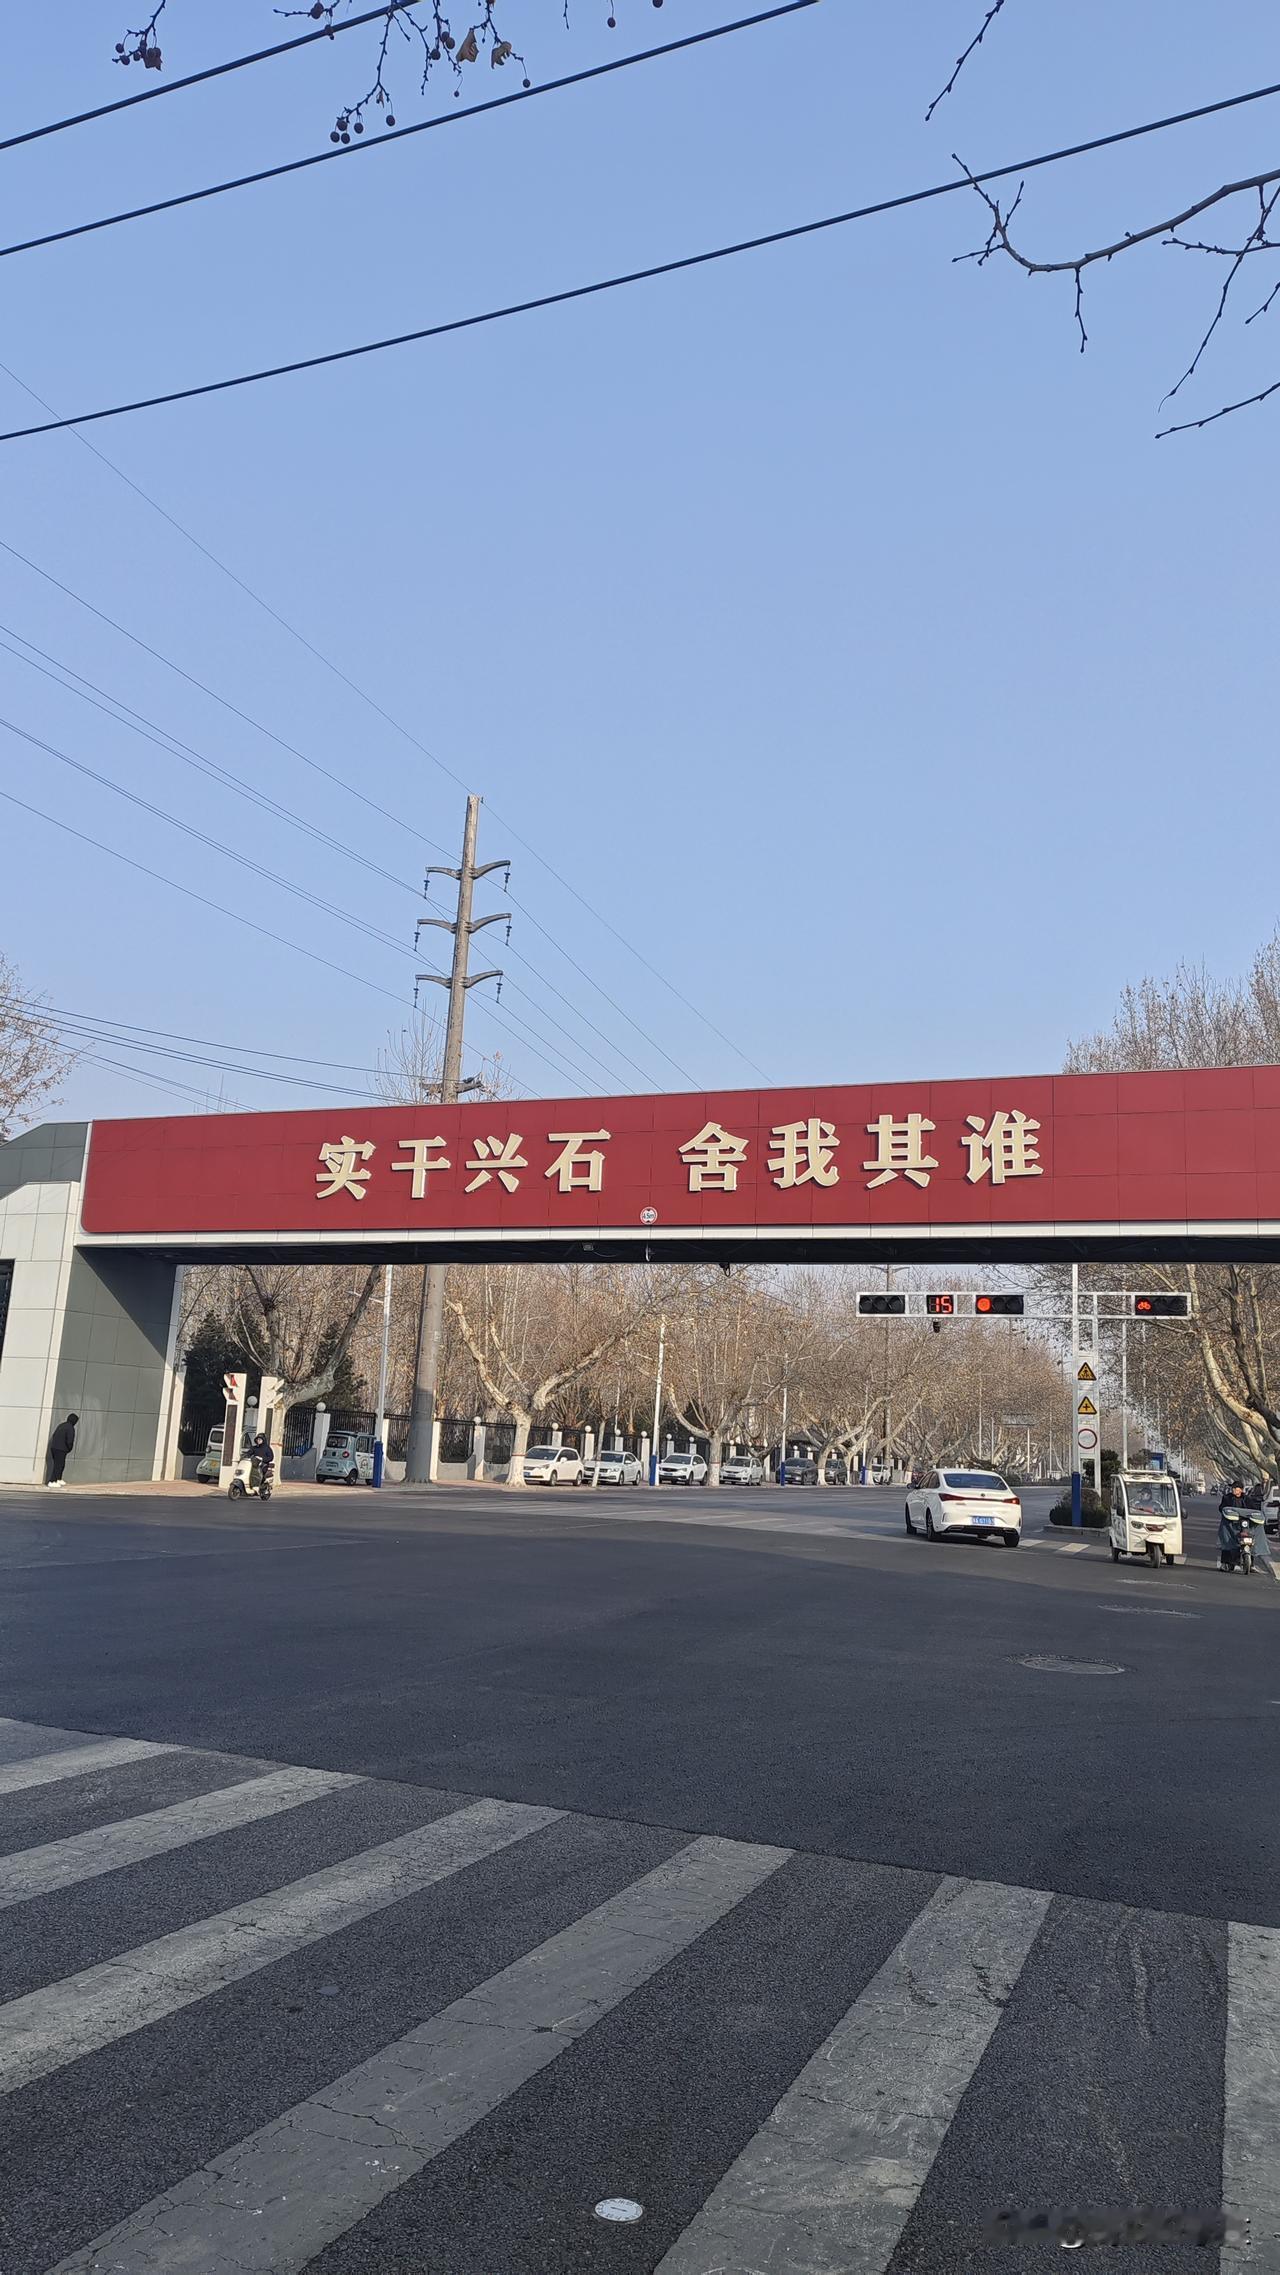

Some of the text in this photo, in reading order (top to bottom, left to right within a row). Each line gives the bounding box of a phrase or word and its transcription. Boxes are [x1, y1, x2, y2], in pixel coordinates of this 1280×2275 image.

[316, 1109, 1044, 1200] 实干兴石 舍我其谁
[935, 1296, 952, 1313] 15
